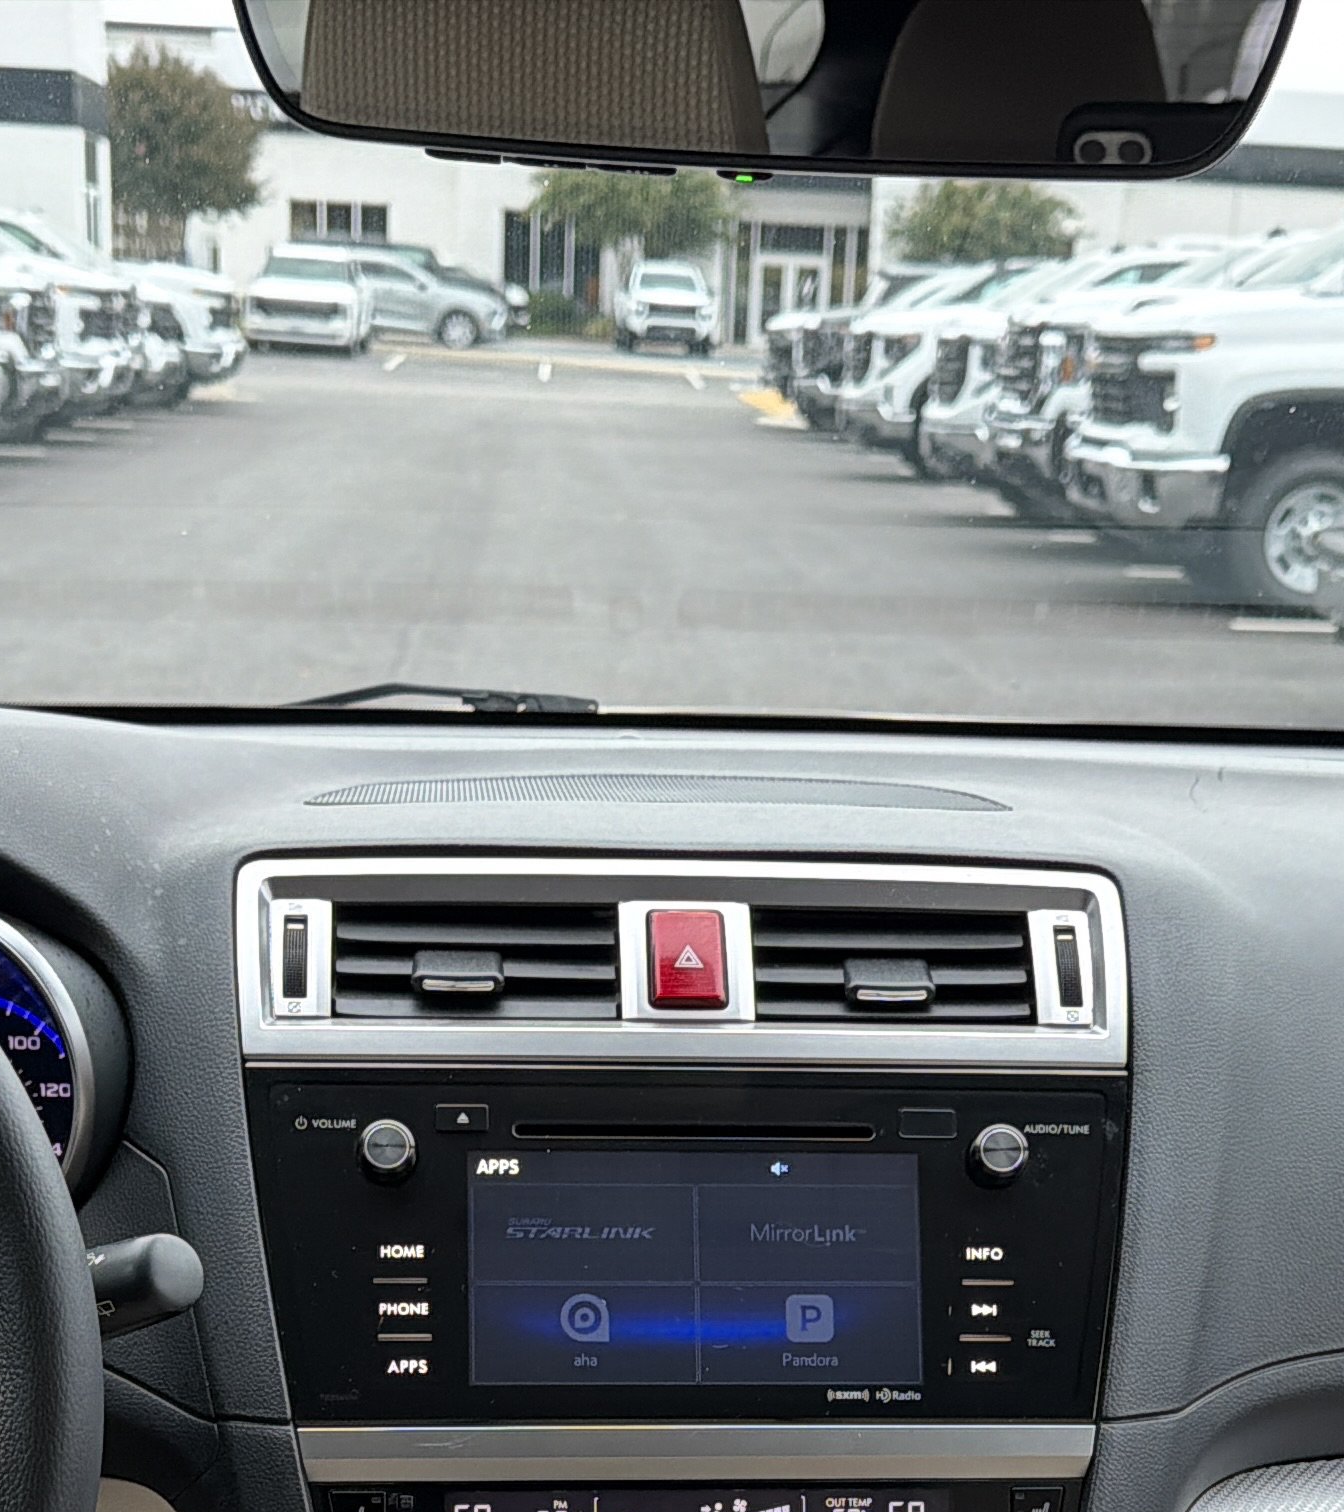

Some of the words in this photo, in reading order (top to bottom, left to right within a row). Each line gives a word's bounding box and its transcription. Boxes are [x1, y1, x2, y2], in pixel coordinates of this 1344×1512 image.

[8, 1036, 41, 1050] 100
[40, 1083, 71, 1098] 120
[312, 1119, 357, 1129] VOLUME
[1023, 1124, 1090, 1135] AUDIO/TUNE
[476, 1158, 521, 1175] APPS
[508, 1217, 552, 1226] SUBARU
[506, 1226, 656, 1239] STARLINK
[750, 1223, 856, 1246] MirrorLink
[379, 1244, 425, 1259] HOME
[965, 1247, 1004, 1261] INFO
[378, 1302, 429, 1316] PHONE
[1030, 1330, 1050, 1339] SEEK
[1027, 1338, 1056, 1348] TRACK
[387, 1359, 429, 1374] APPS
[573, 1353, 598, 1367] aha
[782, 1353, 839, 1367] Pandora
[892, 1390, 922, 1401] Radio
[553, 1500, 568, 1509] PM
[825, 1498, 847, 1508] OUT
[848, 1498, 873, 1507] TEMP
